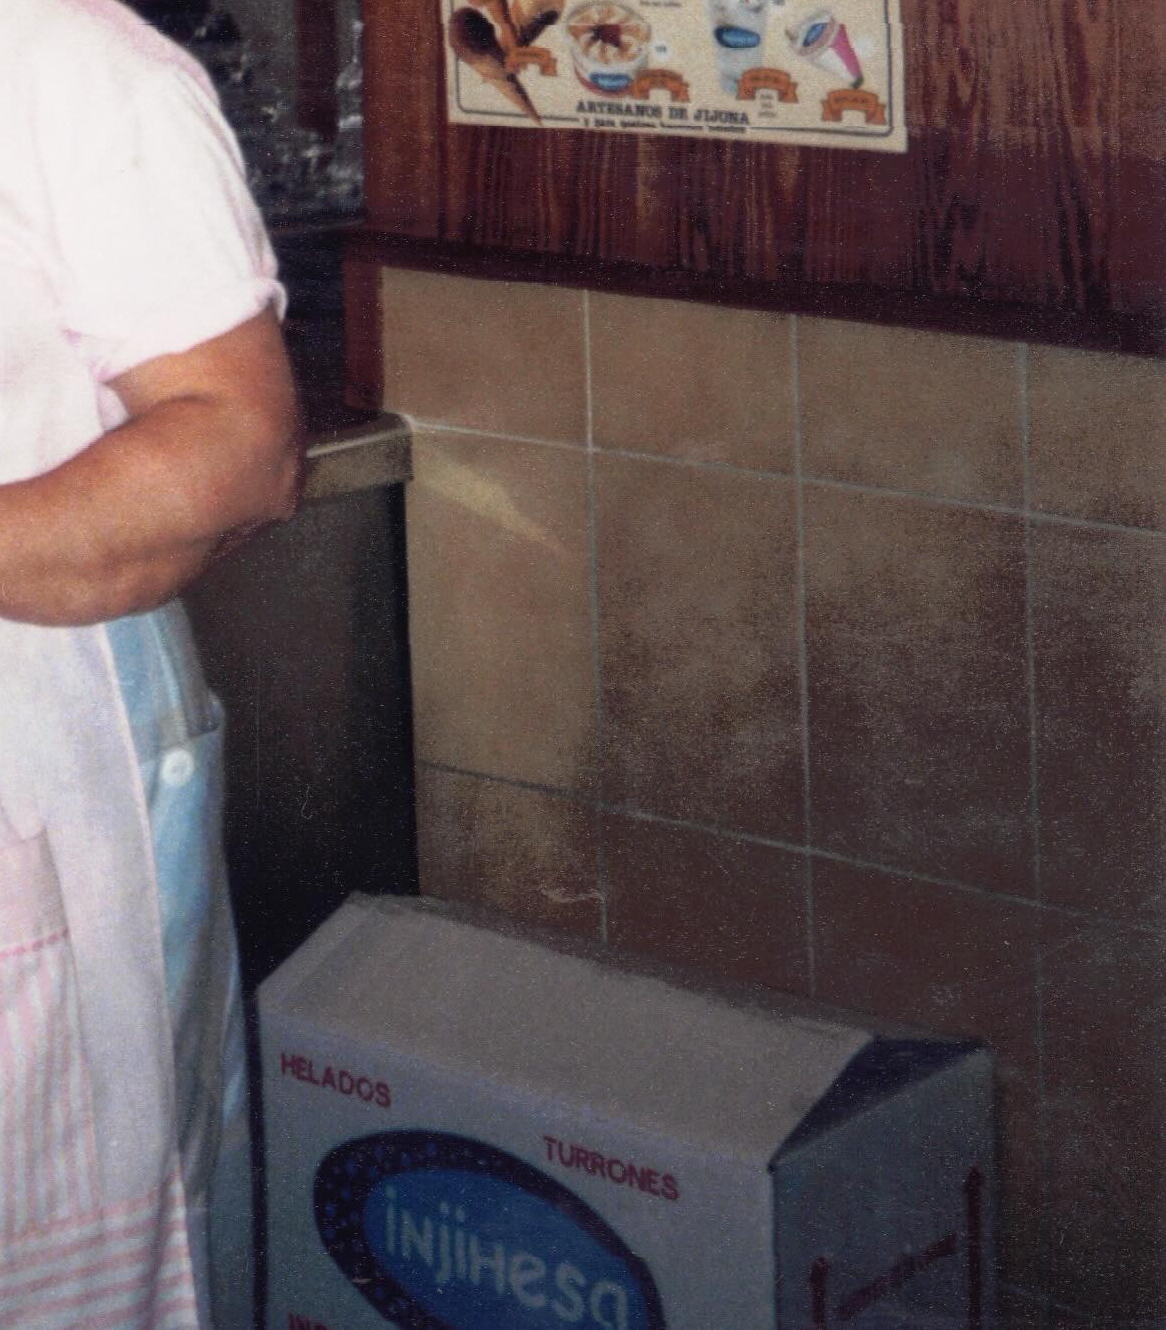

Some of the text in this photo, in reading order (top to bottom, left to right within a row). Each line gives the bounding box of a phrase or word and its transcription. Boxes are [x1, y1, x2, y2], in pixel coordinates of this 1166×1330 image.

[575, 100, 663, 118] ARTESANOS
[669, 106, 688, 120] DE
[280, 1052, 392, 1109] HELADOS
[543, 1135, 681, 1202] TURRONES
